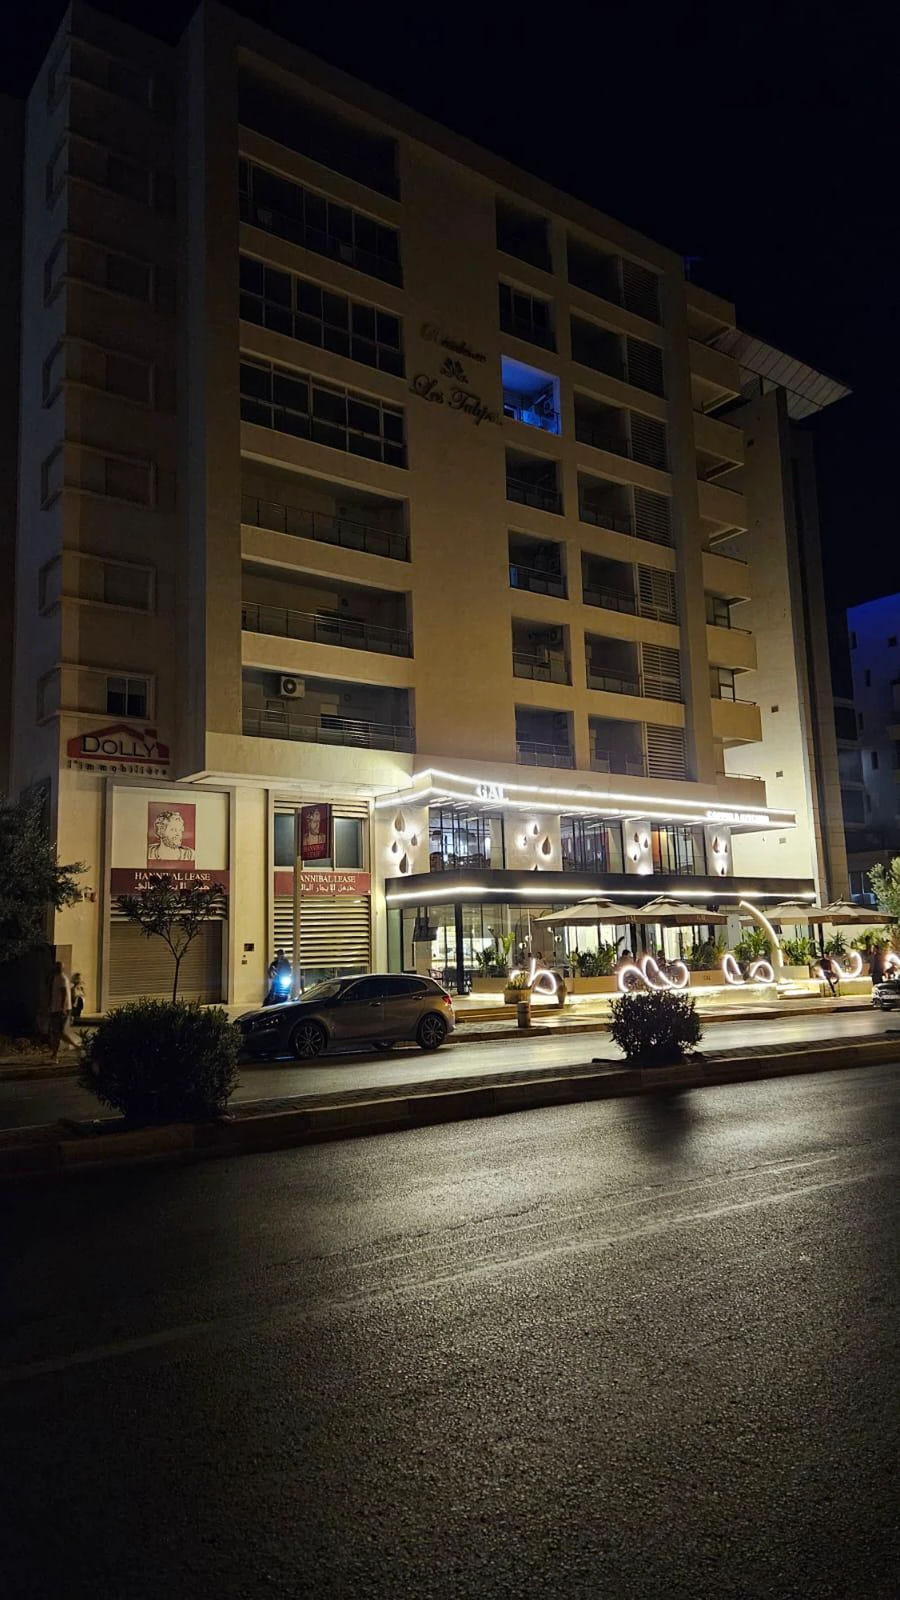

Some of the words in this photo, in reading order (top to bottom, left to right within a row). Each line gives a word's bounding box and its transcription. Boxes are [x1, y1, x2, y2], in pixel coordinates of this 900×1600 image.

[184, 872, 211, 881] LEASE
[300, 874, 333, 883] ANNIBAL
[334, 875, 356, 884] LEASE
